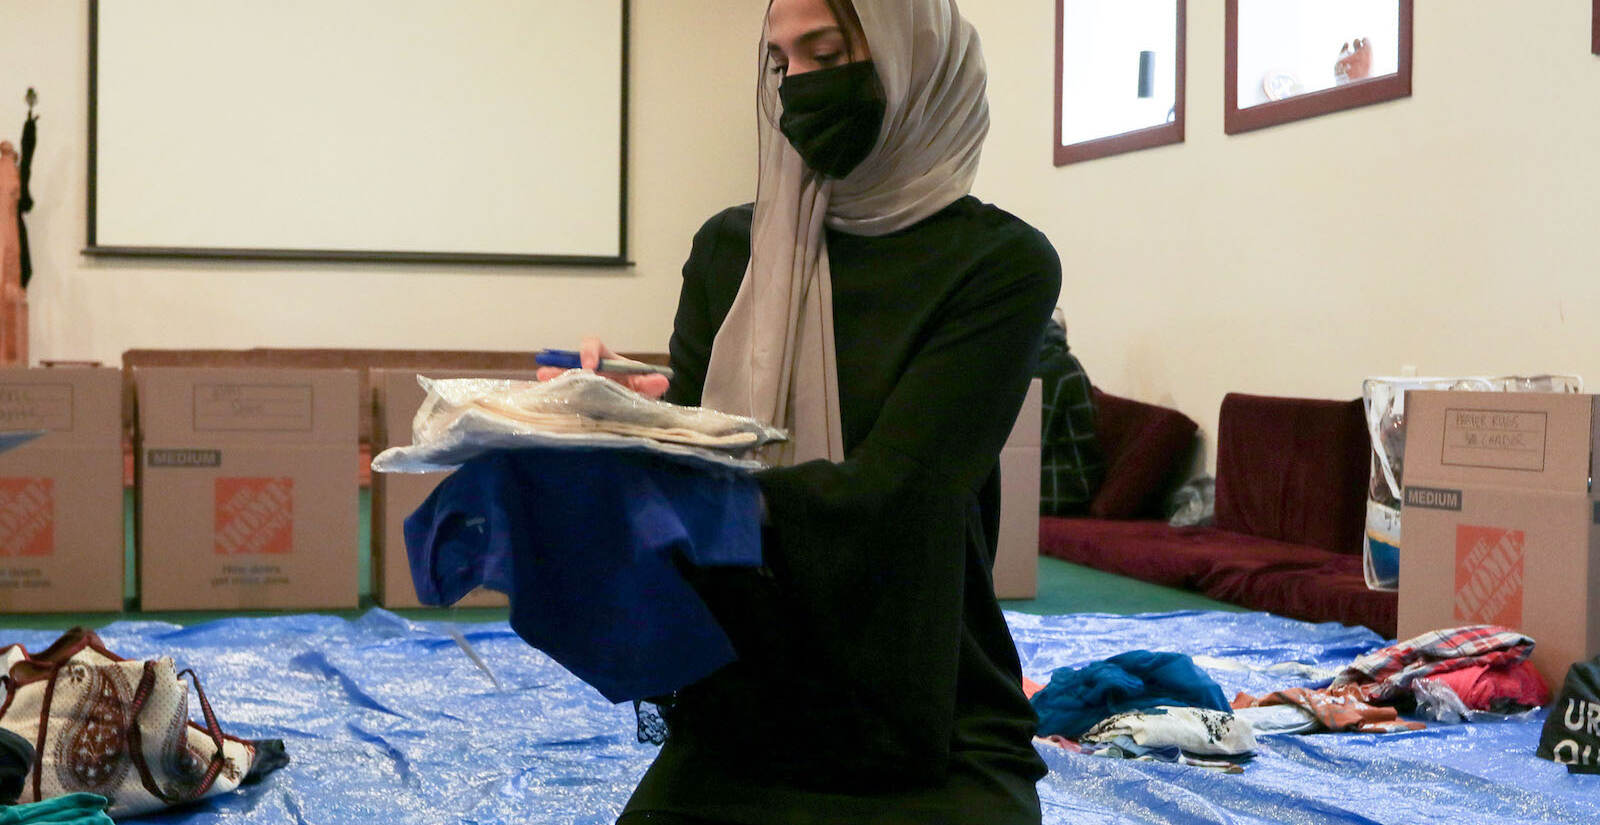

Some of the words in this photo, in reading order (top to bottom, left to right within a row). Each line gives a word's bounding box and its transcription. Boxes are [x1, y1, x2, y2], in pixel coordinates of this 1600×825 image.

[152, 452, 217, 465] MEDIUM
[213, 476, 292, 552] HOME
[1407, 490, 1458, 507] MEDIUM
[1456, 529, 1525, 620] HOME
[1463, 537, 1489, 574] THE
[1480, 567, 1522, 624] DEPOT
